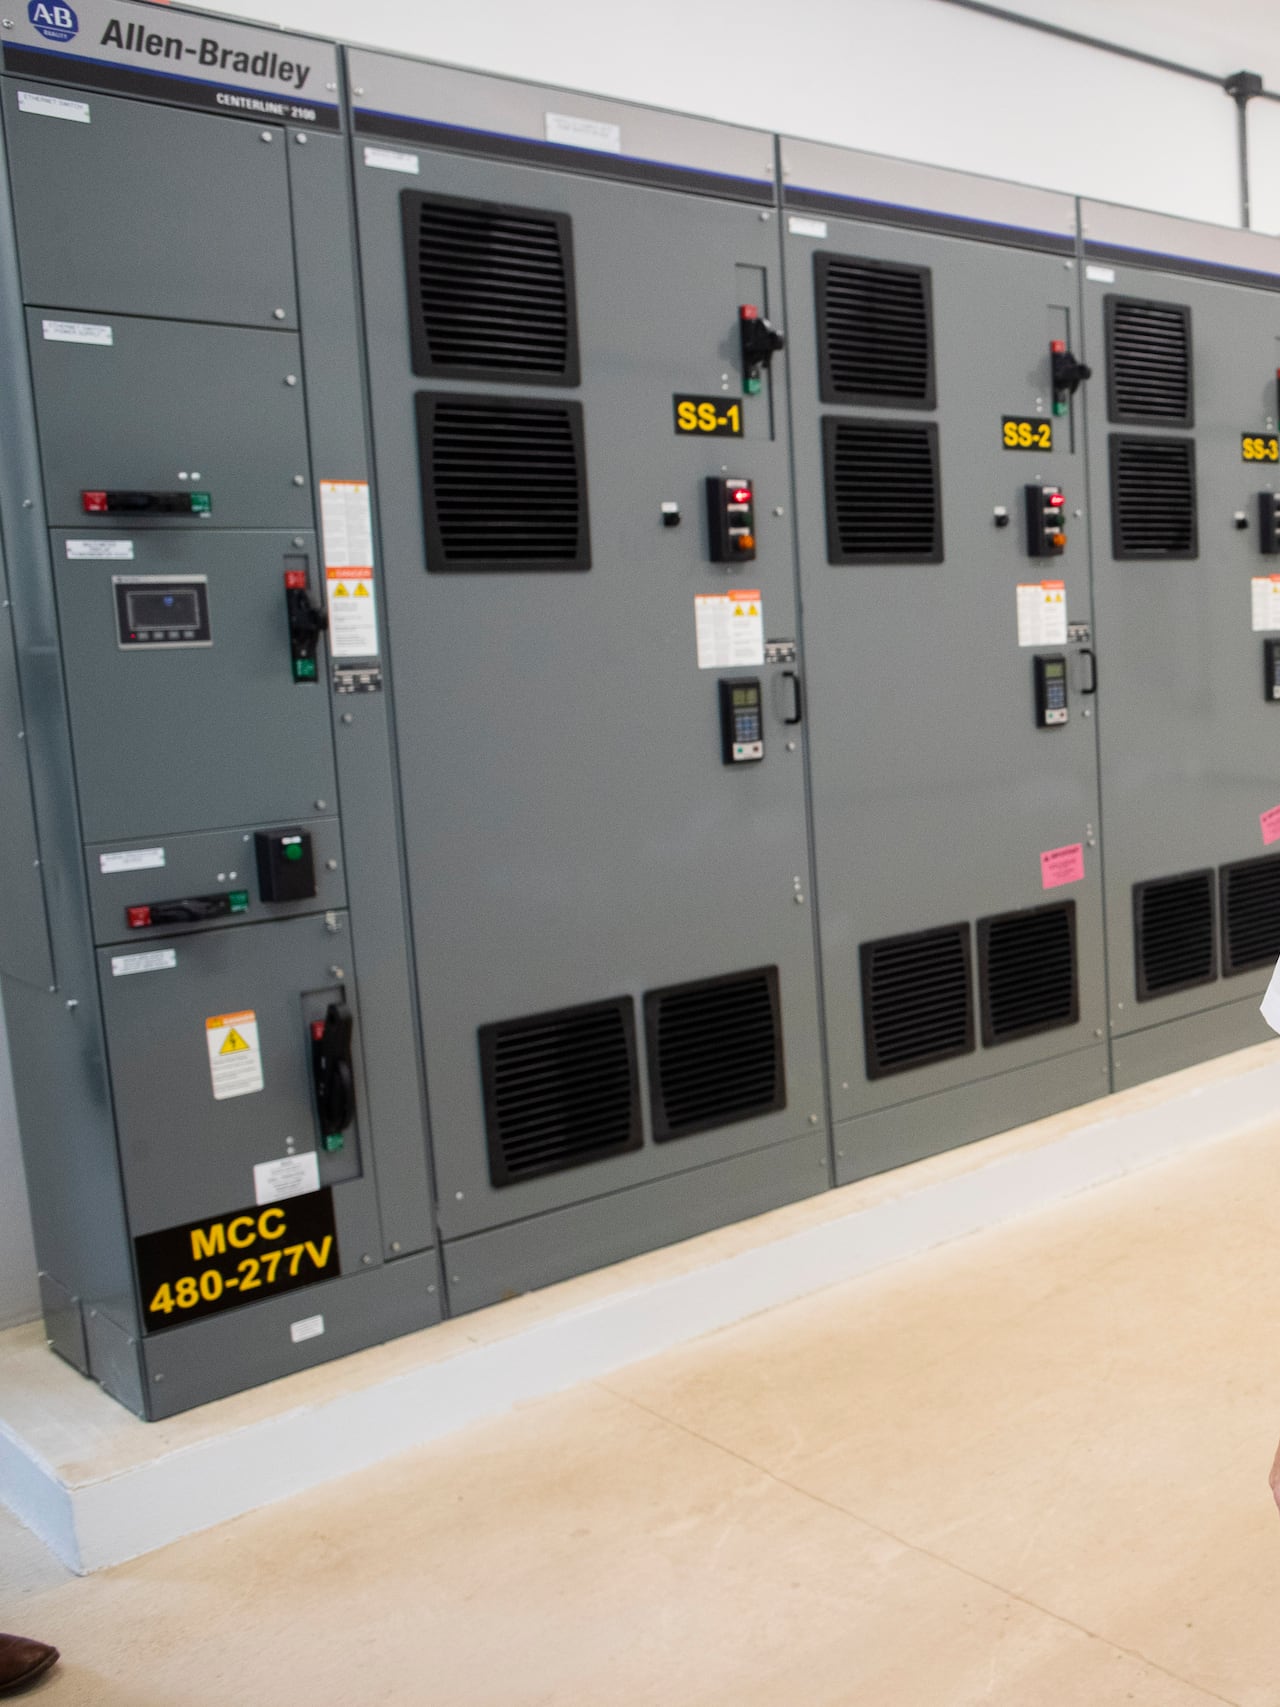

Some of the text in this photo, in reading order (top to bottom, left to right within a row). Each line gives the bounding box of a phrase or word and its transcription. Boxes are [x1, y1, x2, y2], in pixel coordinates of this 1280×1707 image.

[100, 18, 311, 90] Allen-Bradley
[677, 401, 740, 432] SS-1
[1003, 422, 1051, 448] SS-2
[1242, 437, 1279, 461] SS-3
[190, 1207, 287, 1261] MCC
[149, 1235, 333, 1314] 480-277V
